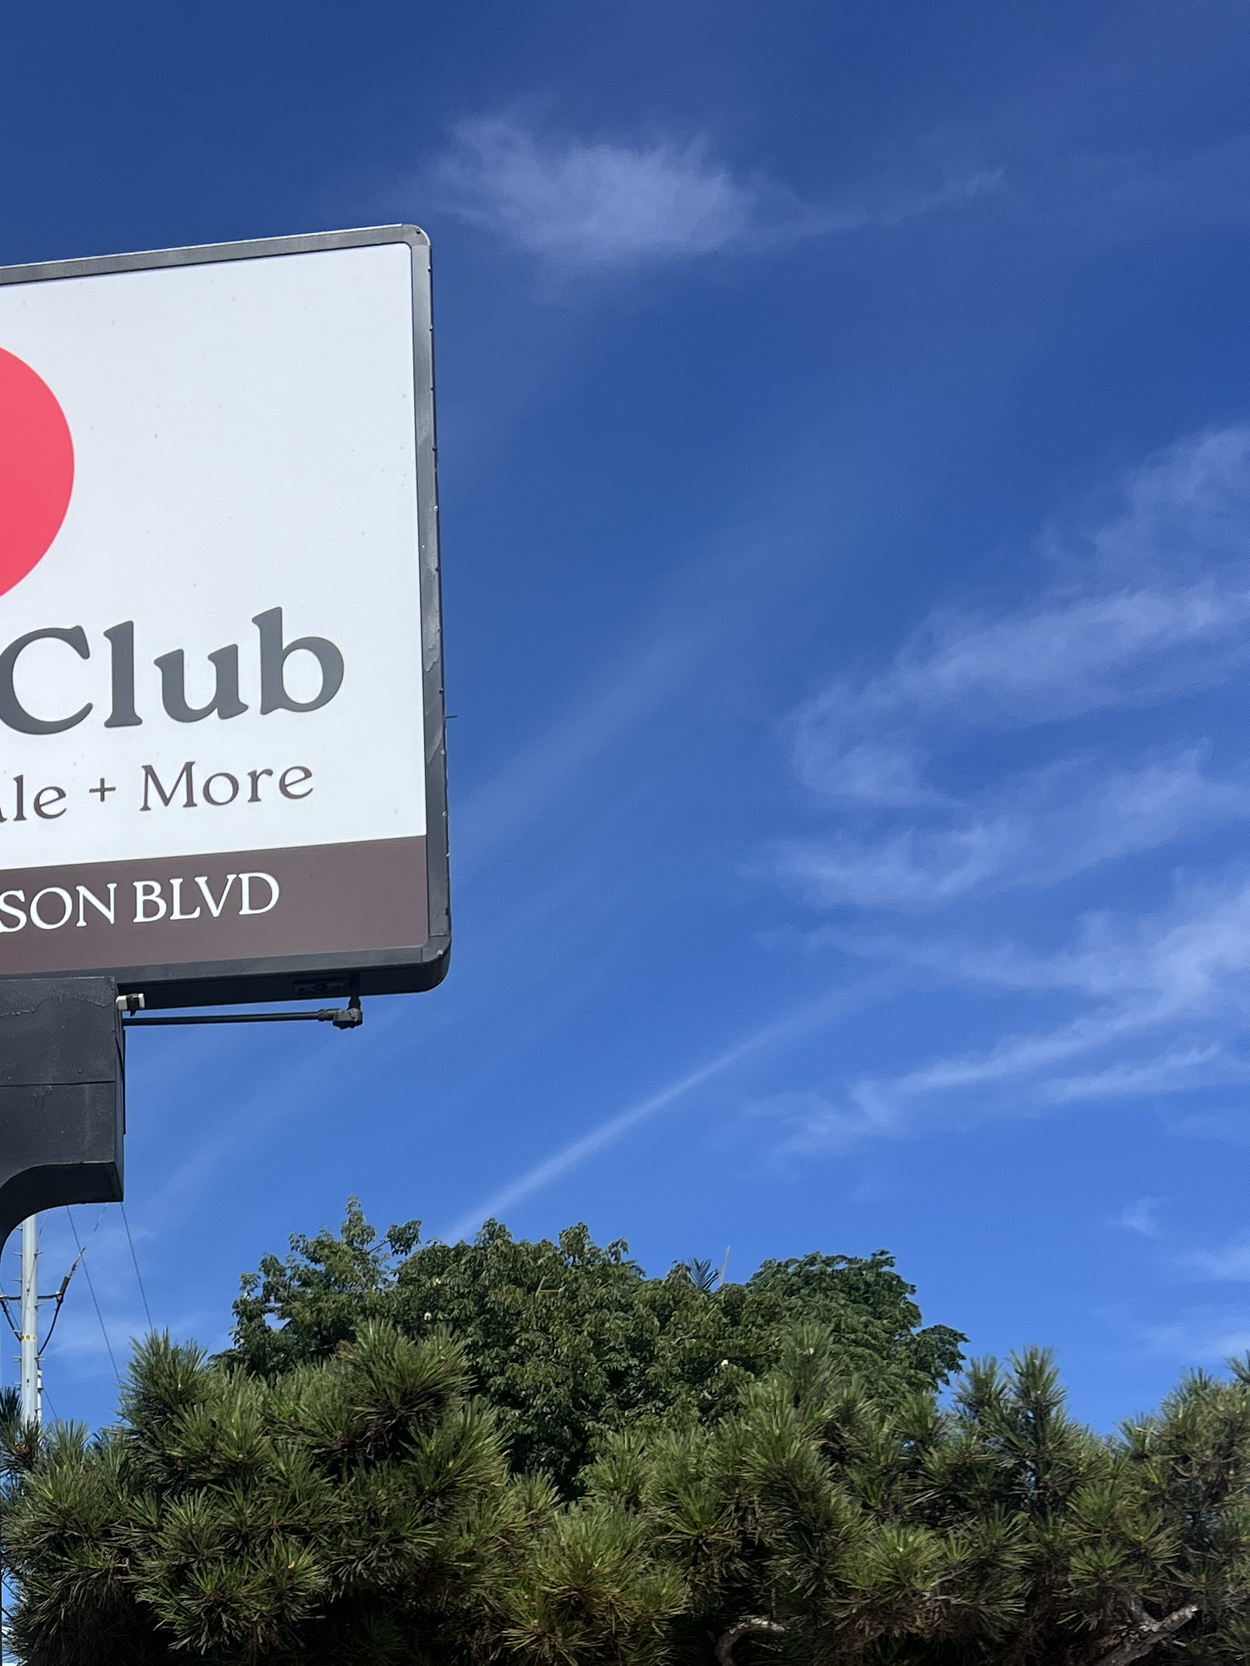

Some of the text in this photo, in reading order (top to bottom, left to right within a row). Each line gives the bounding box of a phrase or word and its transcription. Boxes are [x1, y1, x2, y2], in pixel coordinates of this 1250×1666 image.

[88, 777, 117, 803] +
[139, 760, 314, 812] More
[132, 872, 280, 923] BLVD
